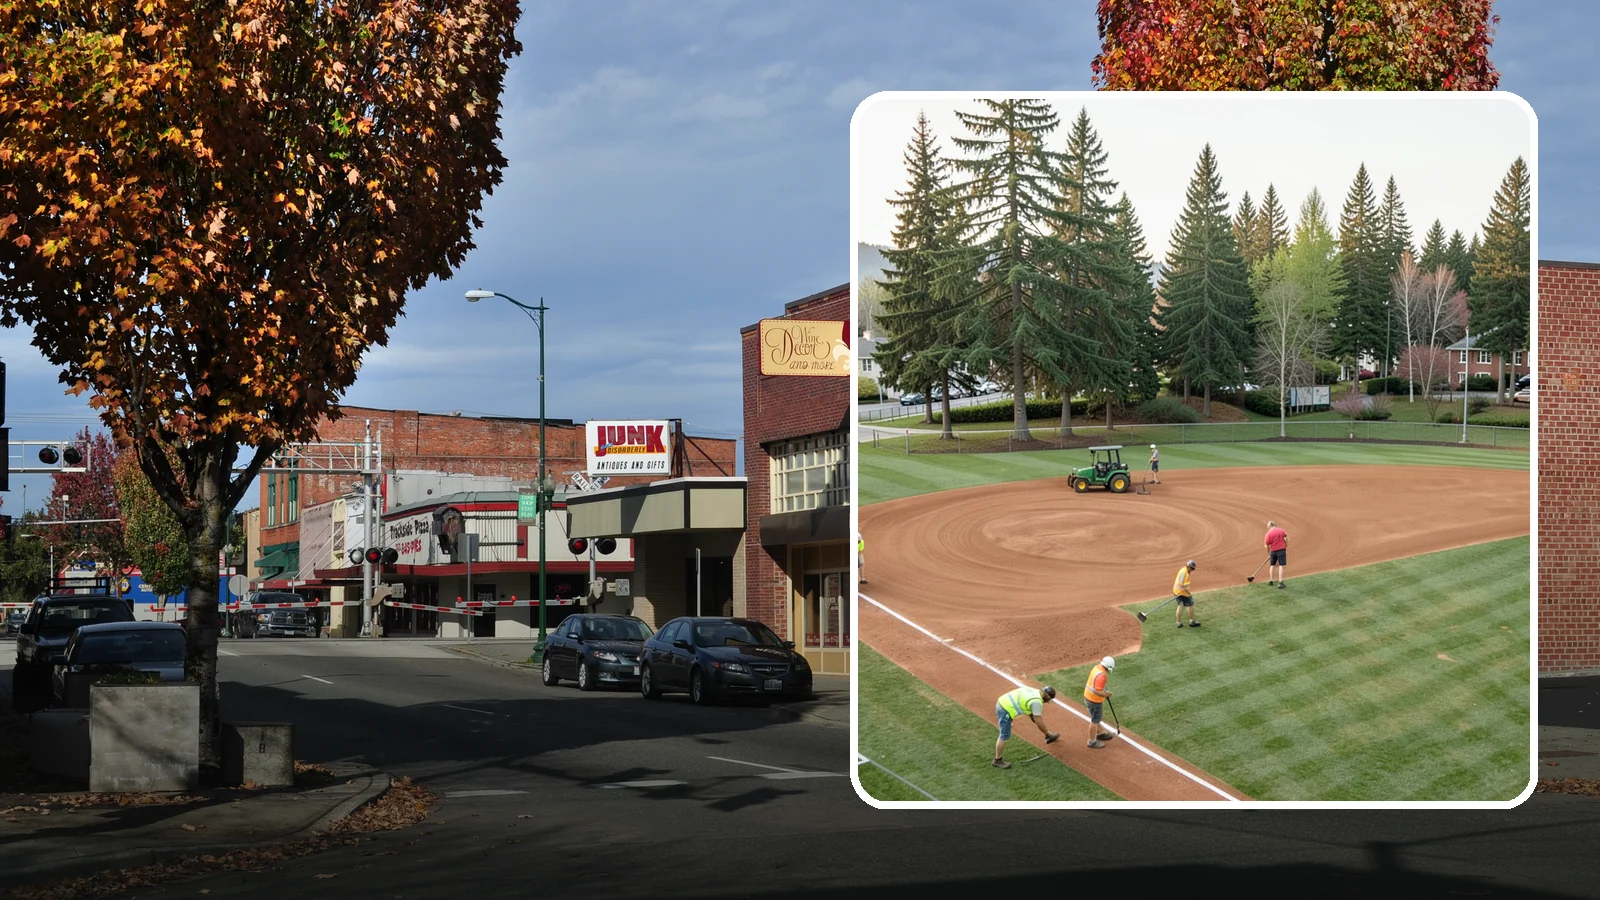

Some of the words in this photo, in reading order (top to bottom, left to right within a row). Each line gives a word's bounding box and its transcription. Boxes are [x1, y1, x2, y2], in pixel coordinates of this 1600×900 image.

[765, 327, 830, 365] Decor
[595, 425, 665, 457] JUNK
[607, 446, 645, 454] DISORDERLY
[597, 461, 628, 470] ANTIQUES
[631, 461, 643, 469] AND
[647, 460, 665, 469] GIFTS
[390, 521, 413, 540] Trackside
[414, 519, 429, 534] Pizza
